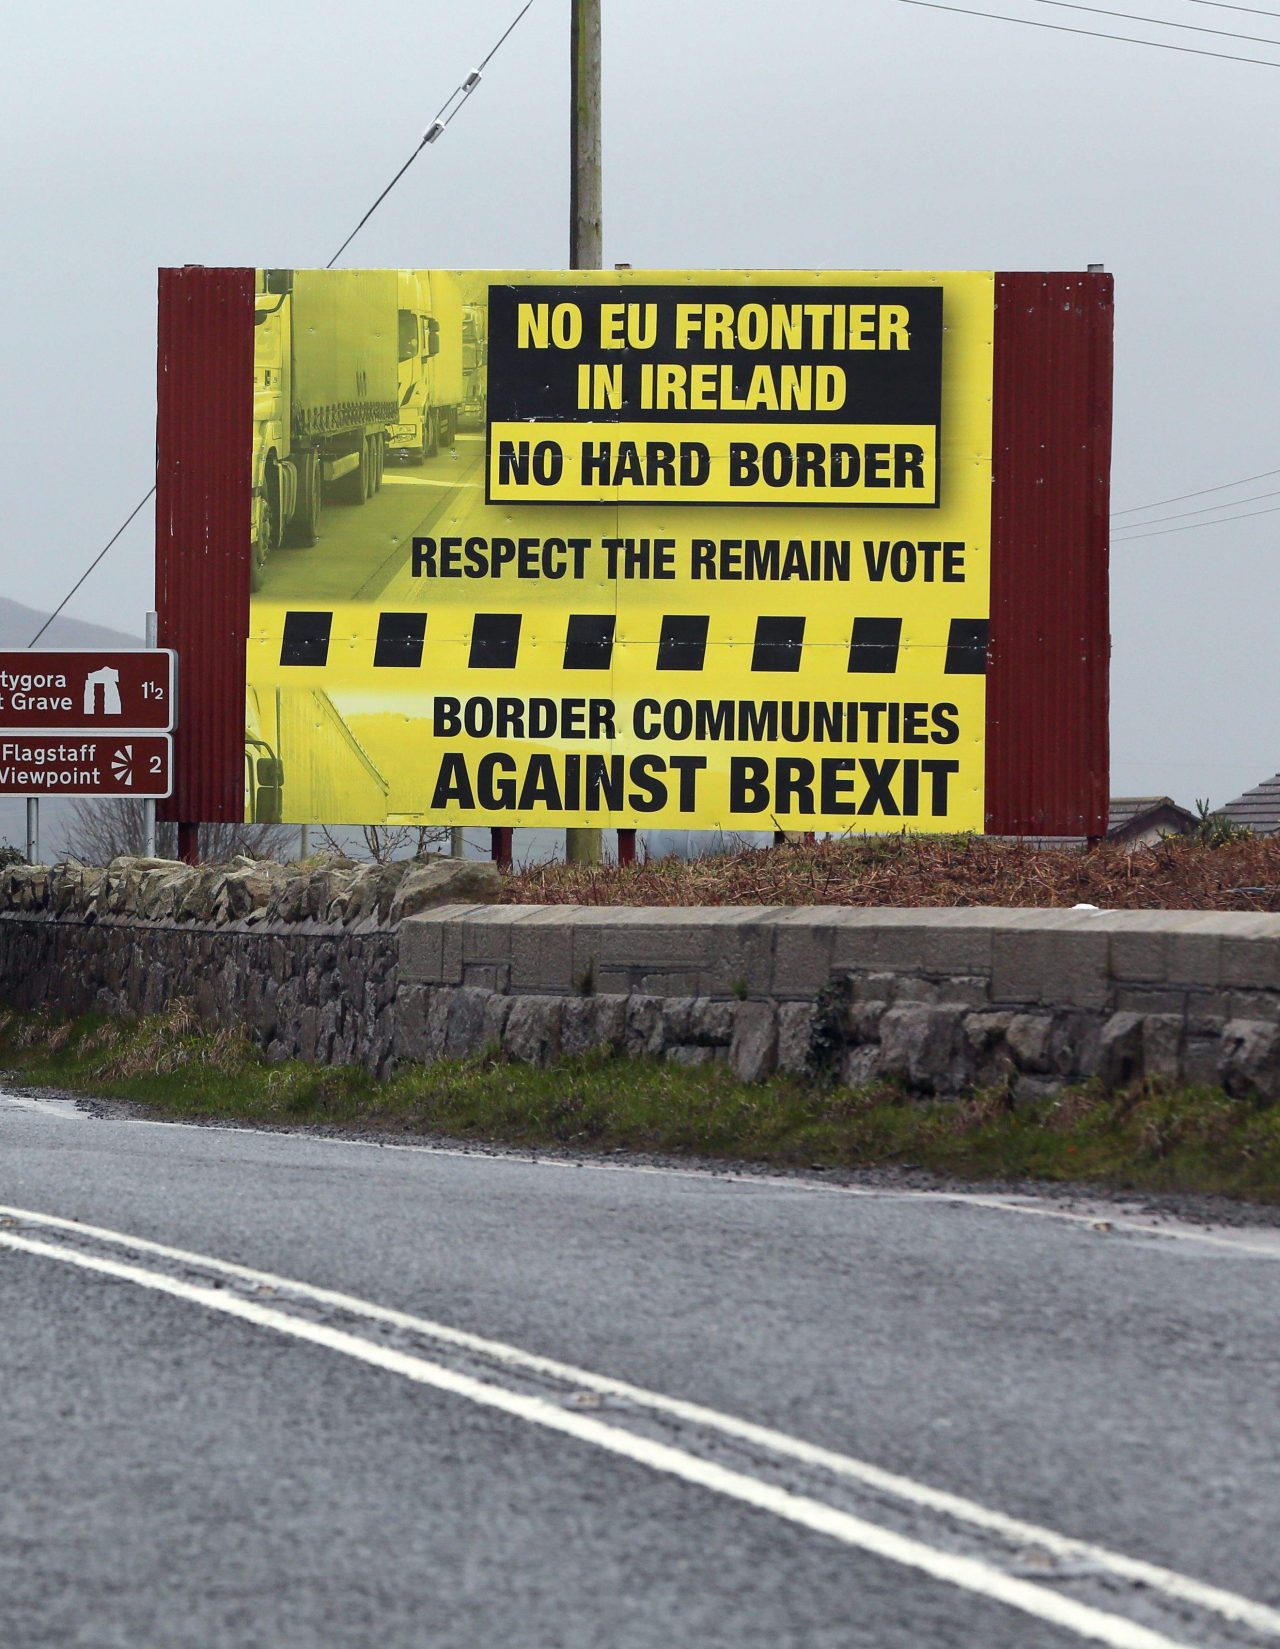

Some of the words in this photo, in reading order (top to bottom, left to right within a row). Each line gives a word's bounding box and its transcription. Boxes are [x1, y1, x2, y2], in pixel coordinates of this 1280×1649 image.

[518, 303, 582, 350] NO
[601, 303, 658, 350] EU
[676, 304, 910, 351] FRONTIER
[577, 364, 623, 410] IN
[641, 364, 847, 411] IRELAND
[499, 440, 563, 486] NO
[581, 441, 711, 487] HARD
[729, 442, 925, 488] BORDER
[412, 537, 591, 580] RESPECT
[601, 539, 676, 580] THE
[692, 540, 851, 582] REMAIN
[862, 541, 966, 583] VOTE
[11, 692, 73, 711] Grave
[433, 697, 616, 740] BORDER
[632, 699, 960, 745] COMMUNITIES
[2, 744, 96, 765] Flagstaff
[149, 756, 162, 773] 2
[431, 753, 707, 813] AGAINST
[729, 757, 960, 817] BREXIT
